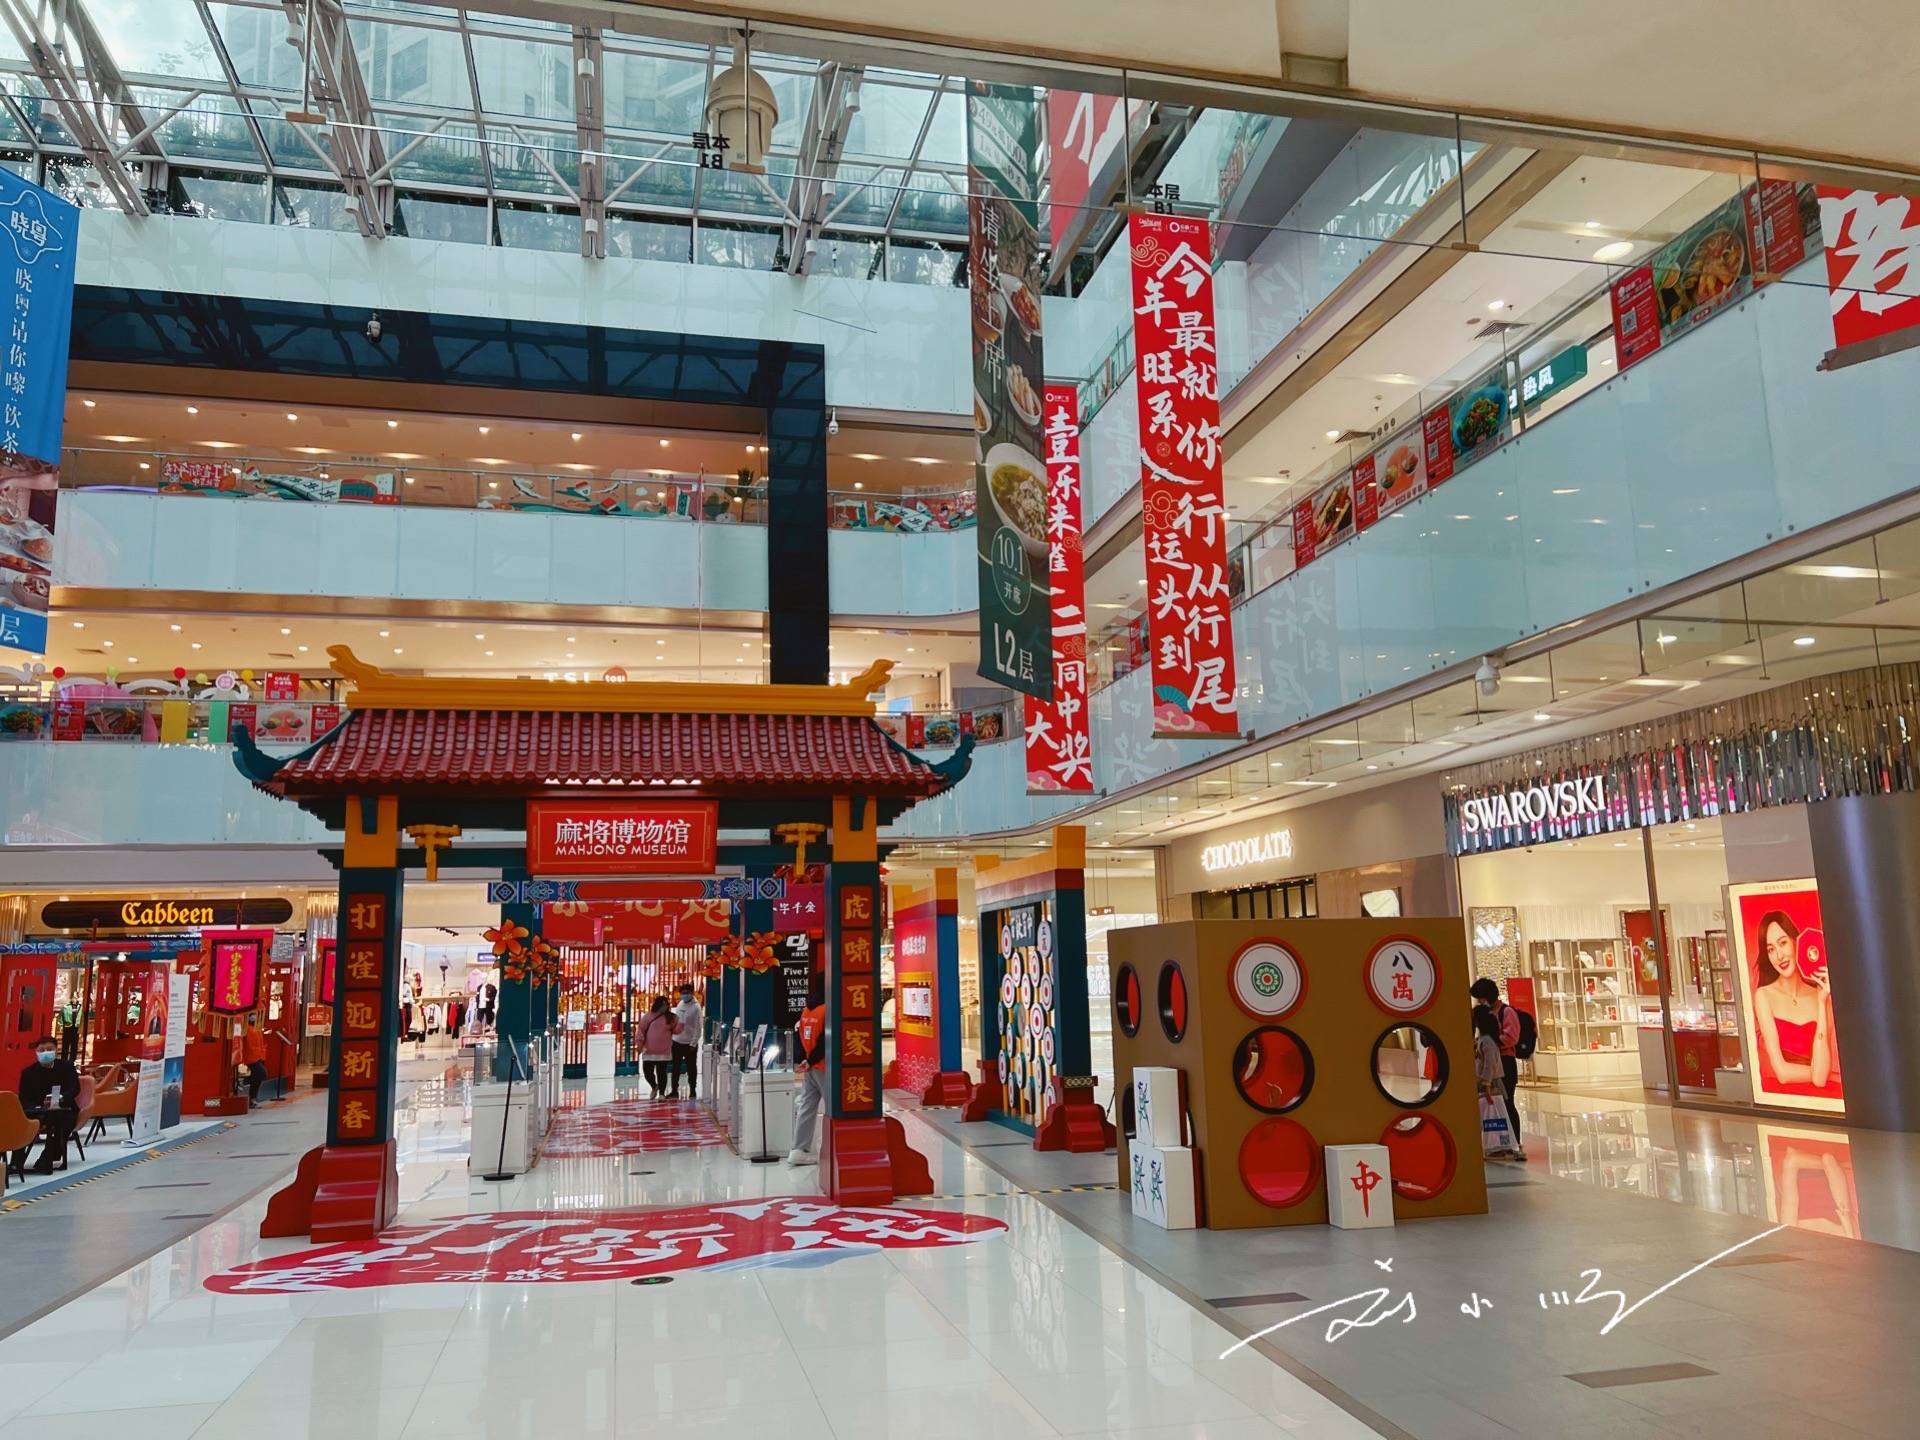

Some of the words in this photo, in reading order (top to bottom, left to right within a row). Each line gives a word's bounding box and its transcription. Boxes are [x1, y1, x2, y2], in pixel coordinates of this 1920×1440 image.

[1147, 184, 1180, 200] 本层
[1155, 201, 1175, 215] B1
[10, 210, 47, 247] 晓粤
[998, 533, 1025, 577] 10.1
[1464, 784, 1606, 832] SWAROVSKI
[555, 818, 691, 845] 麻将博物馆
[556, 844, 626, 856] MAHJONG
[631, 844, 687, 856] MUSEUM
[122, 902, 214, 925] Cabbeen
[773, 901, 816, 914] 字千金
[1392, 951, 1413, 1002] 八萬
[342, 903, 380, 1129] 打雀迎新春
[1350, 1161, 1383, 1218] 中
